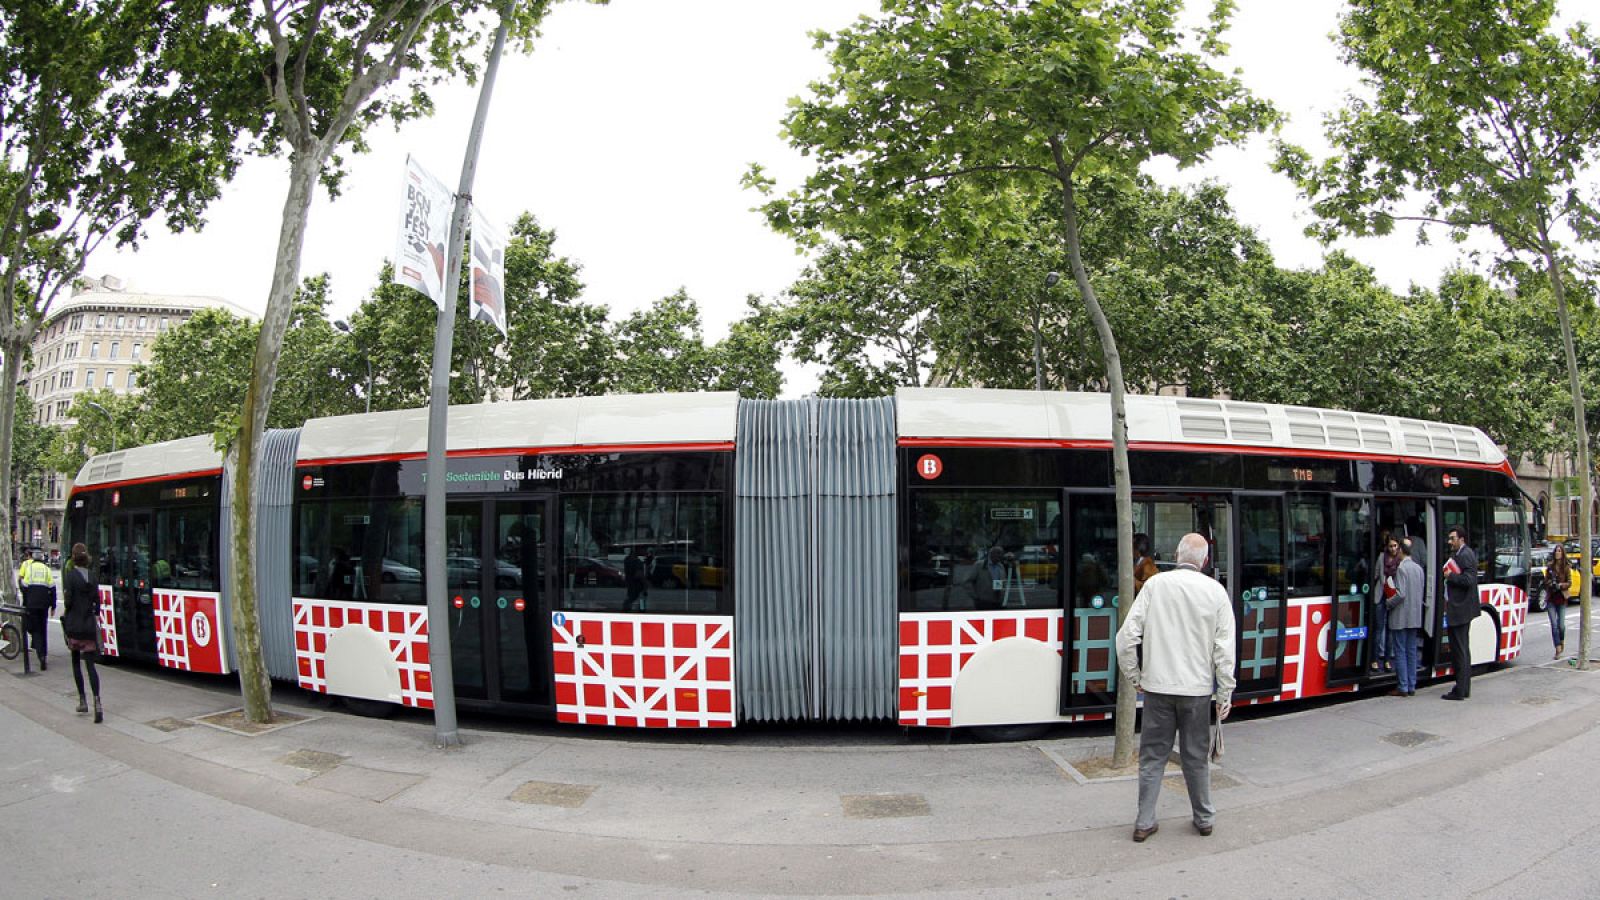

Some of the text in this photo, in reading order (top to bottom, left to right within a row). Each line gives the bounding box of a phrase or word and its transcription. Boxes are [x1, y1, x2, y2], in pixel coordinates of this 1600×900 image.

[408, 184, 431, 214] BCN
[405, 213, 430, 241] FEST
[446, 470, 501, 482] Sostenible
[503, 470, 525, 481] Bus
[1292, 468, 1313, 481] TMB
